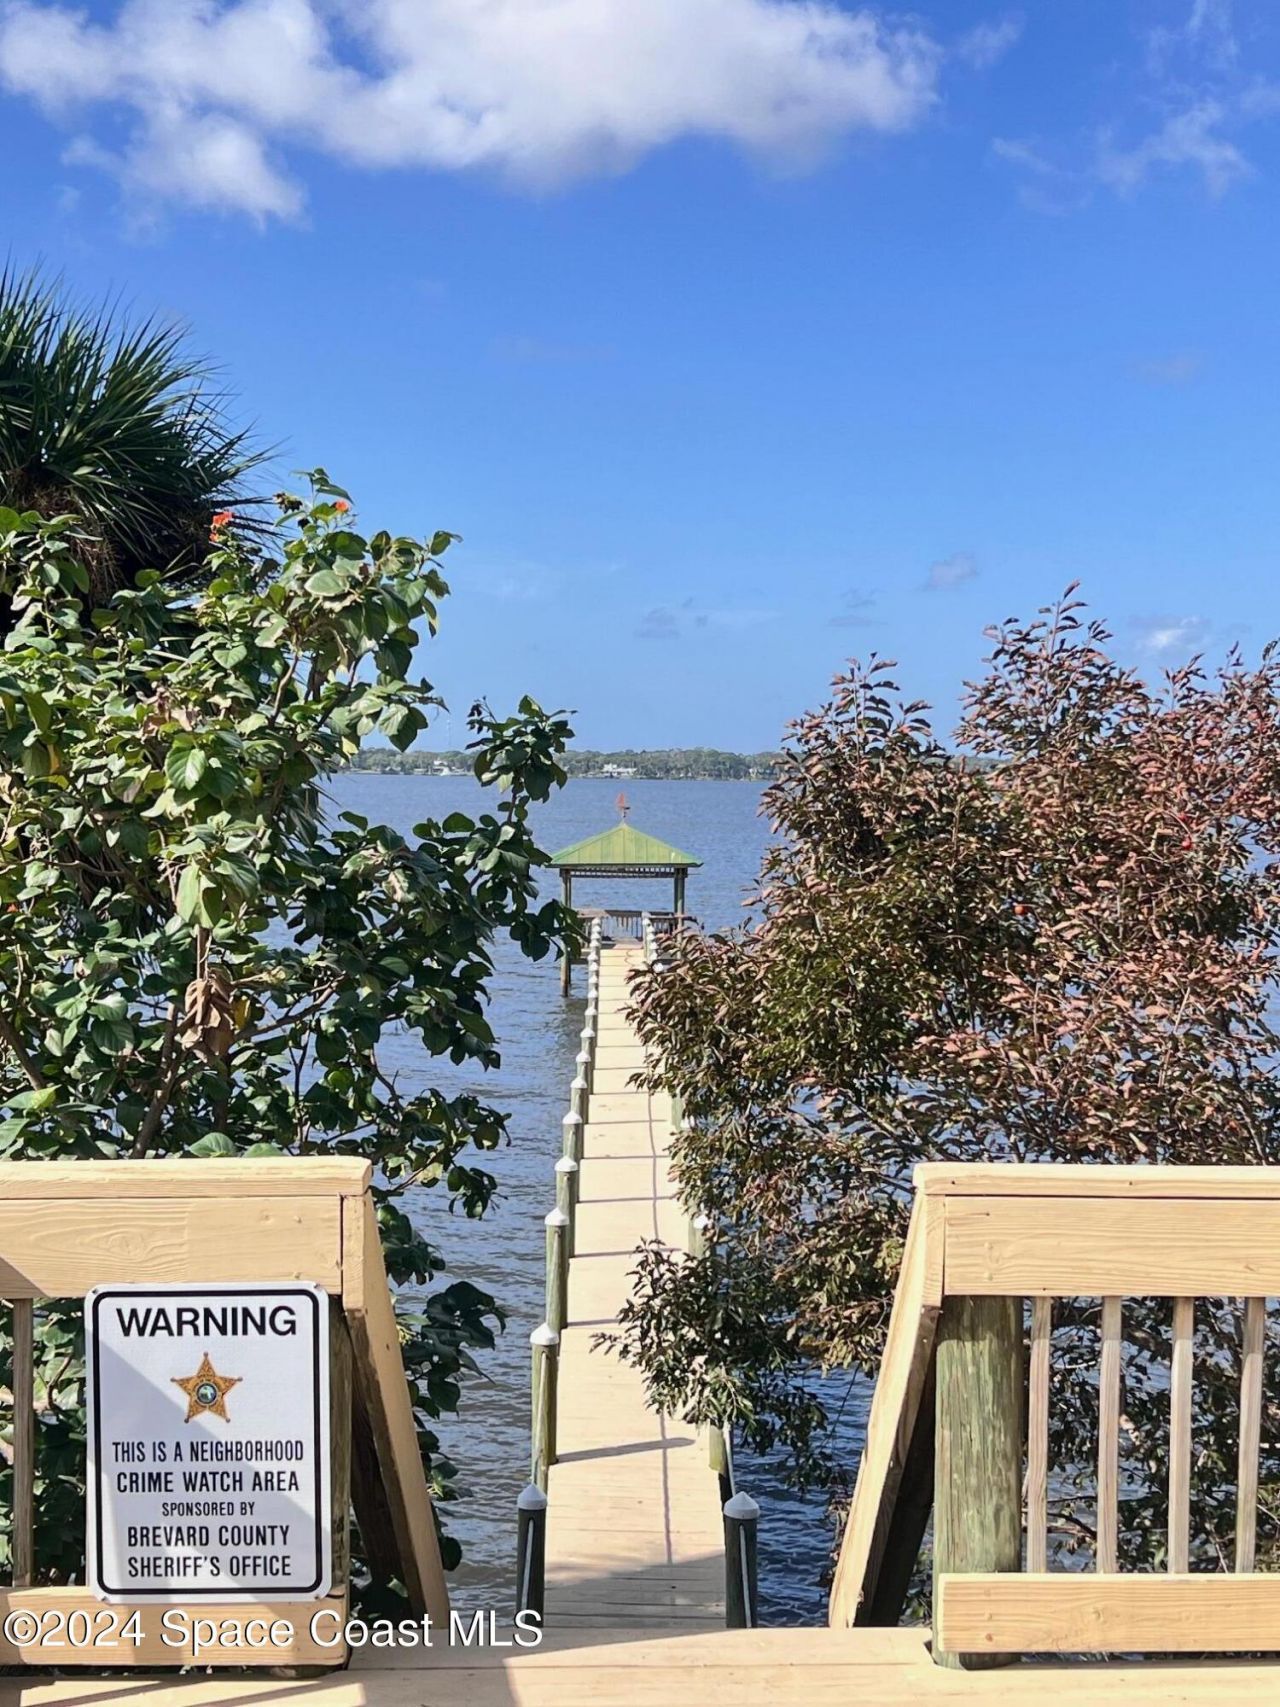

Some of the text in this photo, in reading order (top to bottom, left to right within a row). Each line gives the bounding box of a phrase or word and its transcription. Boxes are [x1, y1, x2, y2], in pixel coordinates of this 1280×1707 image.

[116, 1305, 296, 1337] WARNING
[113, 1440, 303, 1462] THIS IS A NEIGHBORHOOD
[117, 1471, 299, 1493] CRIME WATCH AREA
[162, 1502, 255, 1517] SPONSORED BY
[128, 1525, 290, 1547] BREVARD COUNTY
[129, 1555, 291, 1577] SHERIFF'S OFFICE
